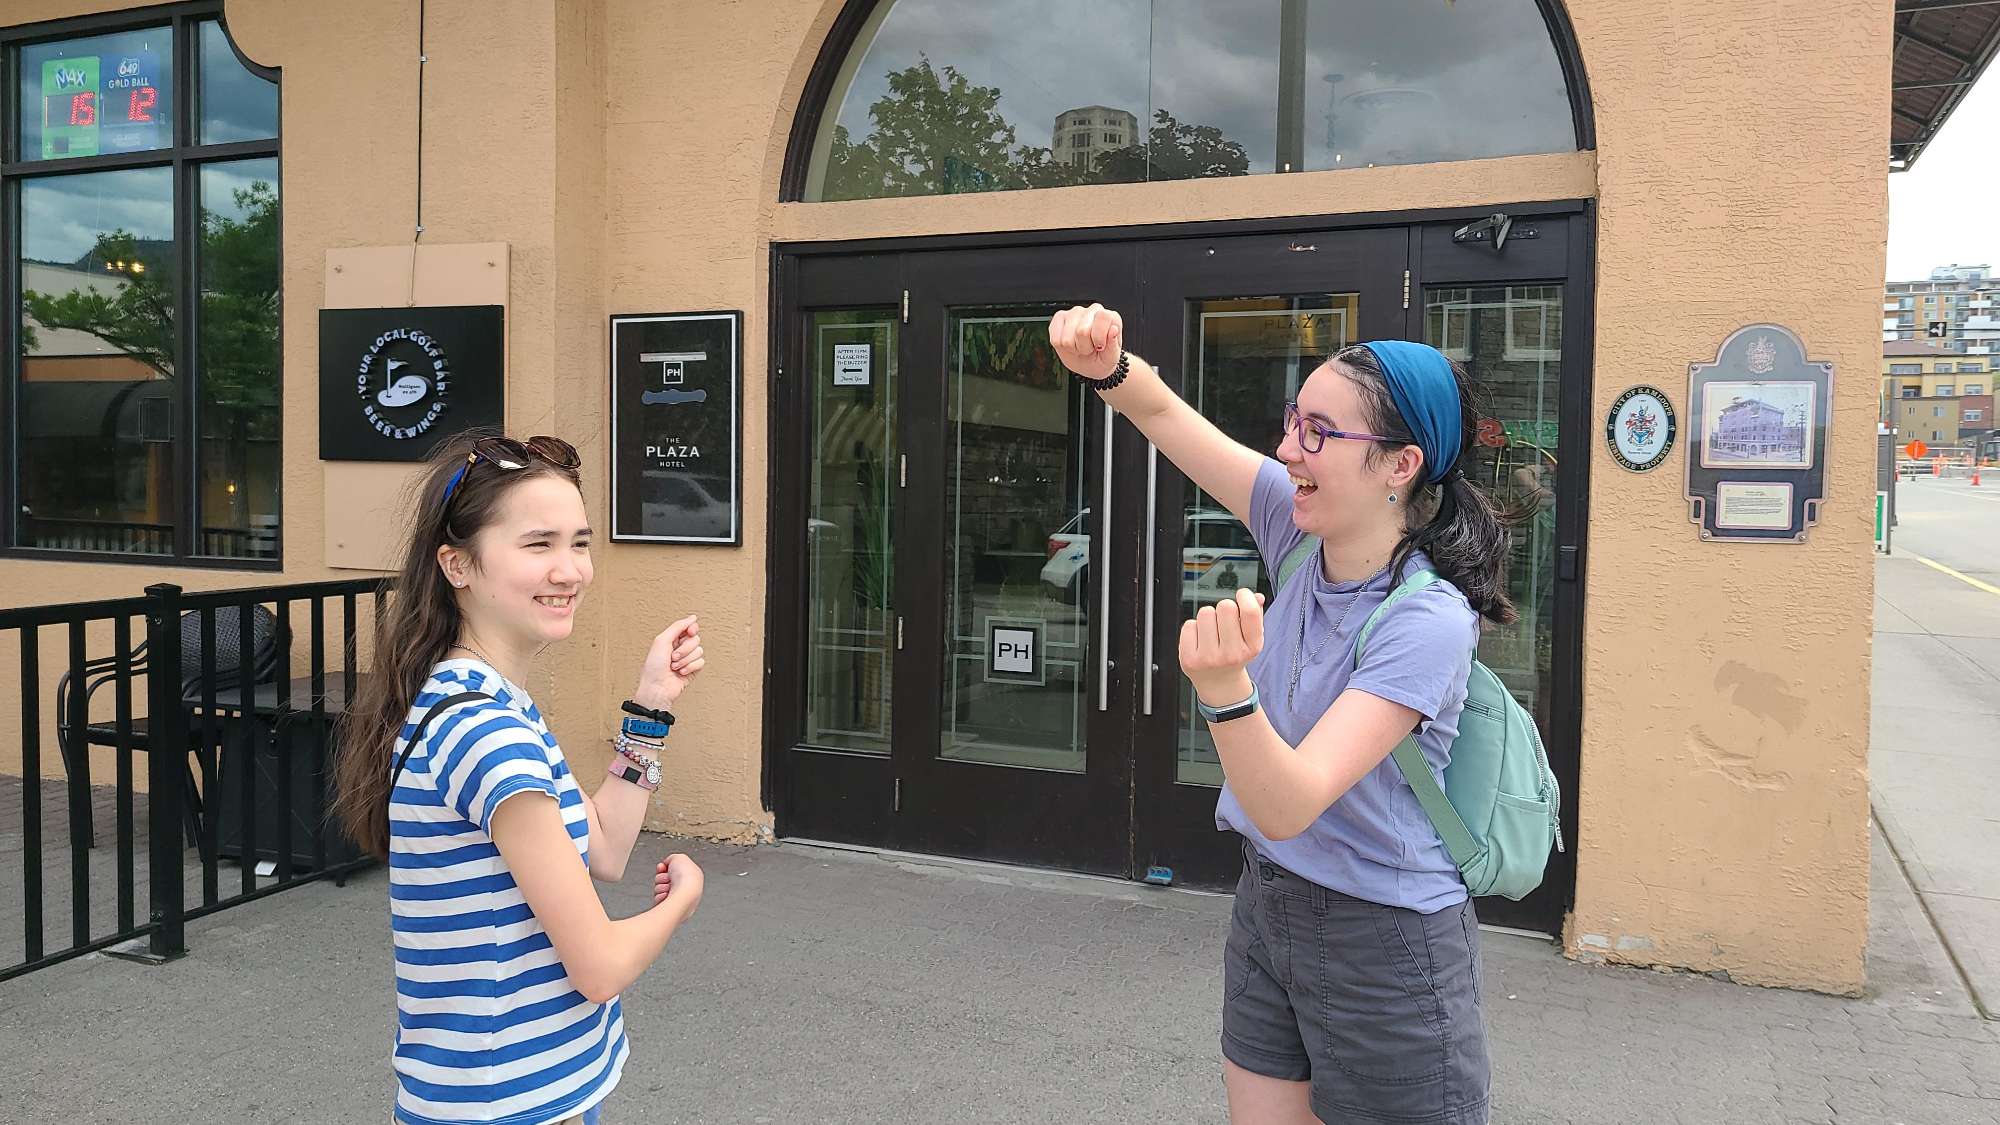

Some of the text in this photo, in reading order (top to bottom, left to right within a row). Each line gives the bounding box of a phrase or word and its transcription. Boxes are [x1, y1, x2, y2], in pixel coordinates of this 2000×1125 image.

[55, 68, 86, 89] MAX
[119, 60, 138, 76] 649
[108, 76, 149, 89] GOLD BALL
[70, 91, 96, 126] 15
[127, 87, 157, 121] 12
[358, 354, 373, 394] YOUR
[370, 328, 407, 353] LOCAL
[409, 331, 438, 358] GOLF
[667, 368, 681, 377] PH
[1612, 387, 1673, 417] CITY OF KAMLOOPS
[364, 402, 441, 439] BEER & WINGS
[646, 446, 700, 458] PLAZA
[1640, 441, 1673, 470] PROPERTY
[998, 643, 1029, 659] PH
